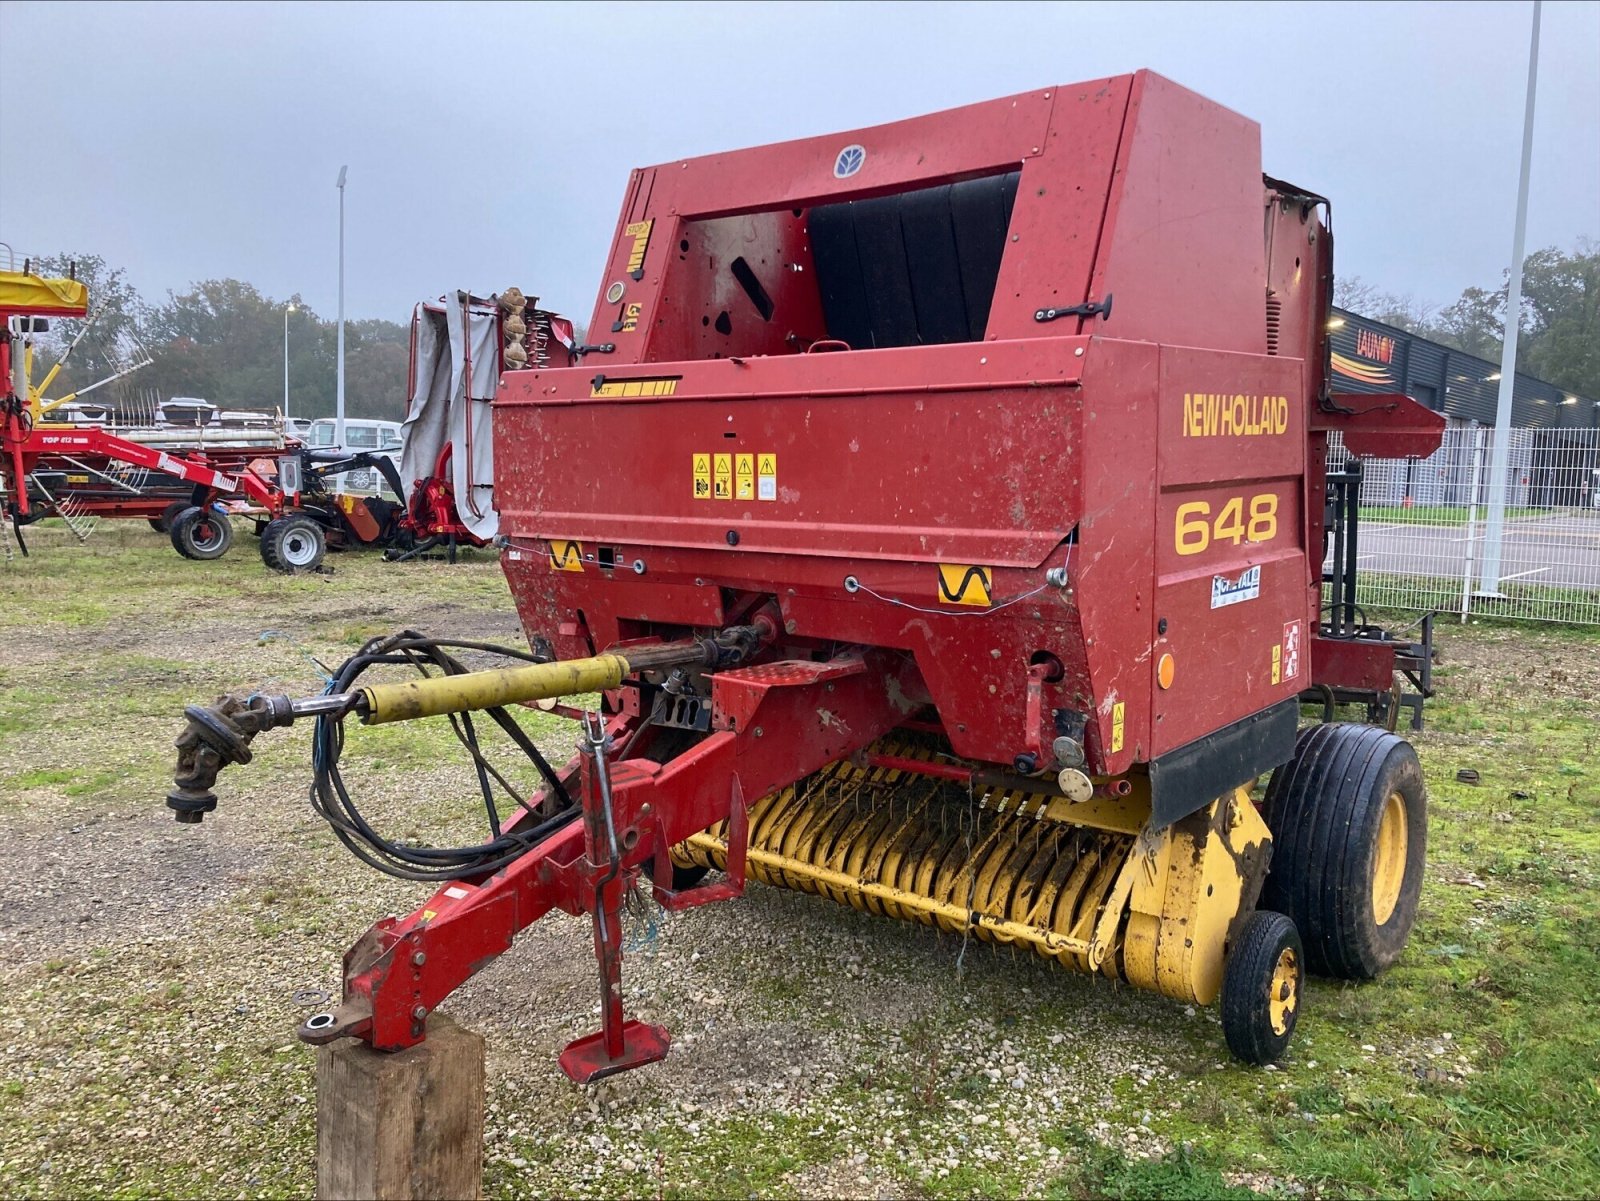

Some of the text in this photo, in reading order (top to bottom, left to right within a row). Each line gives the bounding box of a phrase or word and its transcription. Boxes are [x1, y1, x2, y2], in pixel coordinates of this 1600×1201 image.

[627, 224, 643, 234] STOP
[1183, 393, 1289, 437] NEW HOLLAND
[42, 436, 60, 444] TOP
[1175, 493, 1278, 556] 648
